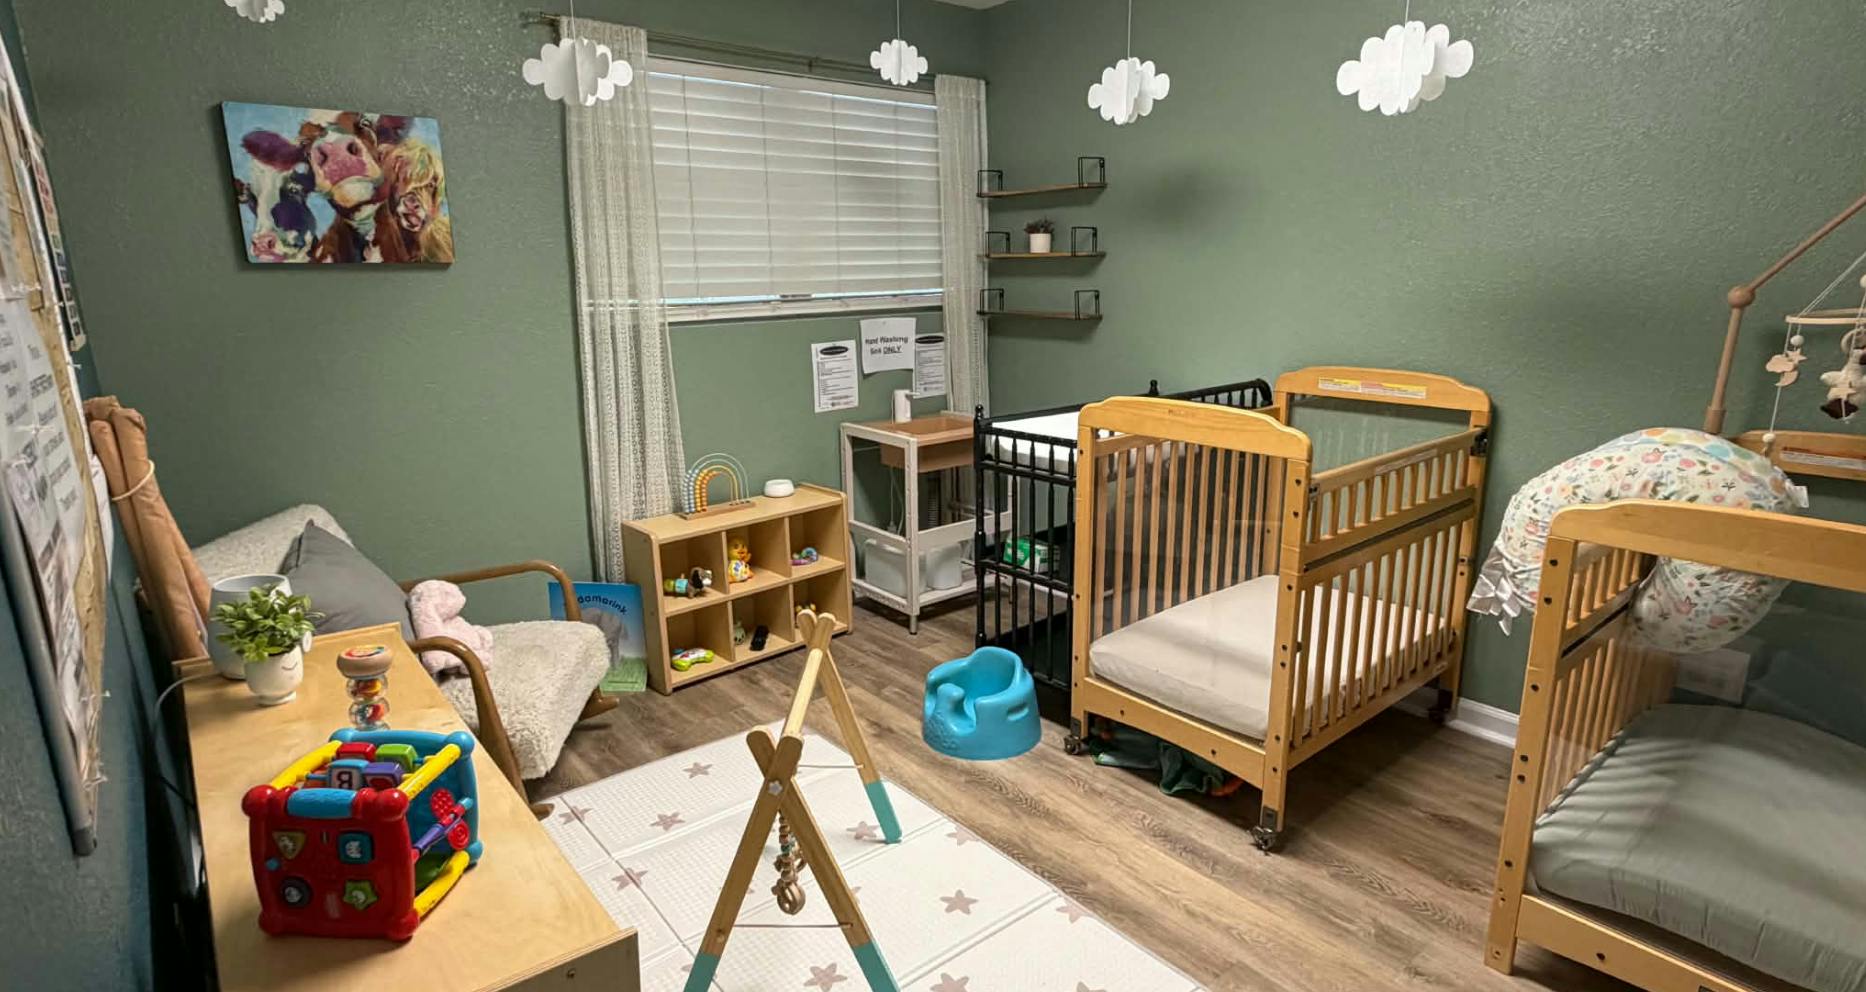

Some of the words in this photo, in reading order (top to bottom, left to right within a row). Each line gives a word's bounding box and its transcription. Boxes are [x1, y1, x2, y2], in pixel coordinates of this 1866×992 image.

[879, 336, 908, 344] Washing
[883, 345, 902, 354] ONLY
[577, 595, 628, 615] damarink
